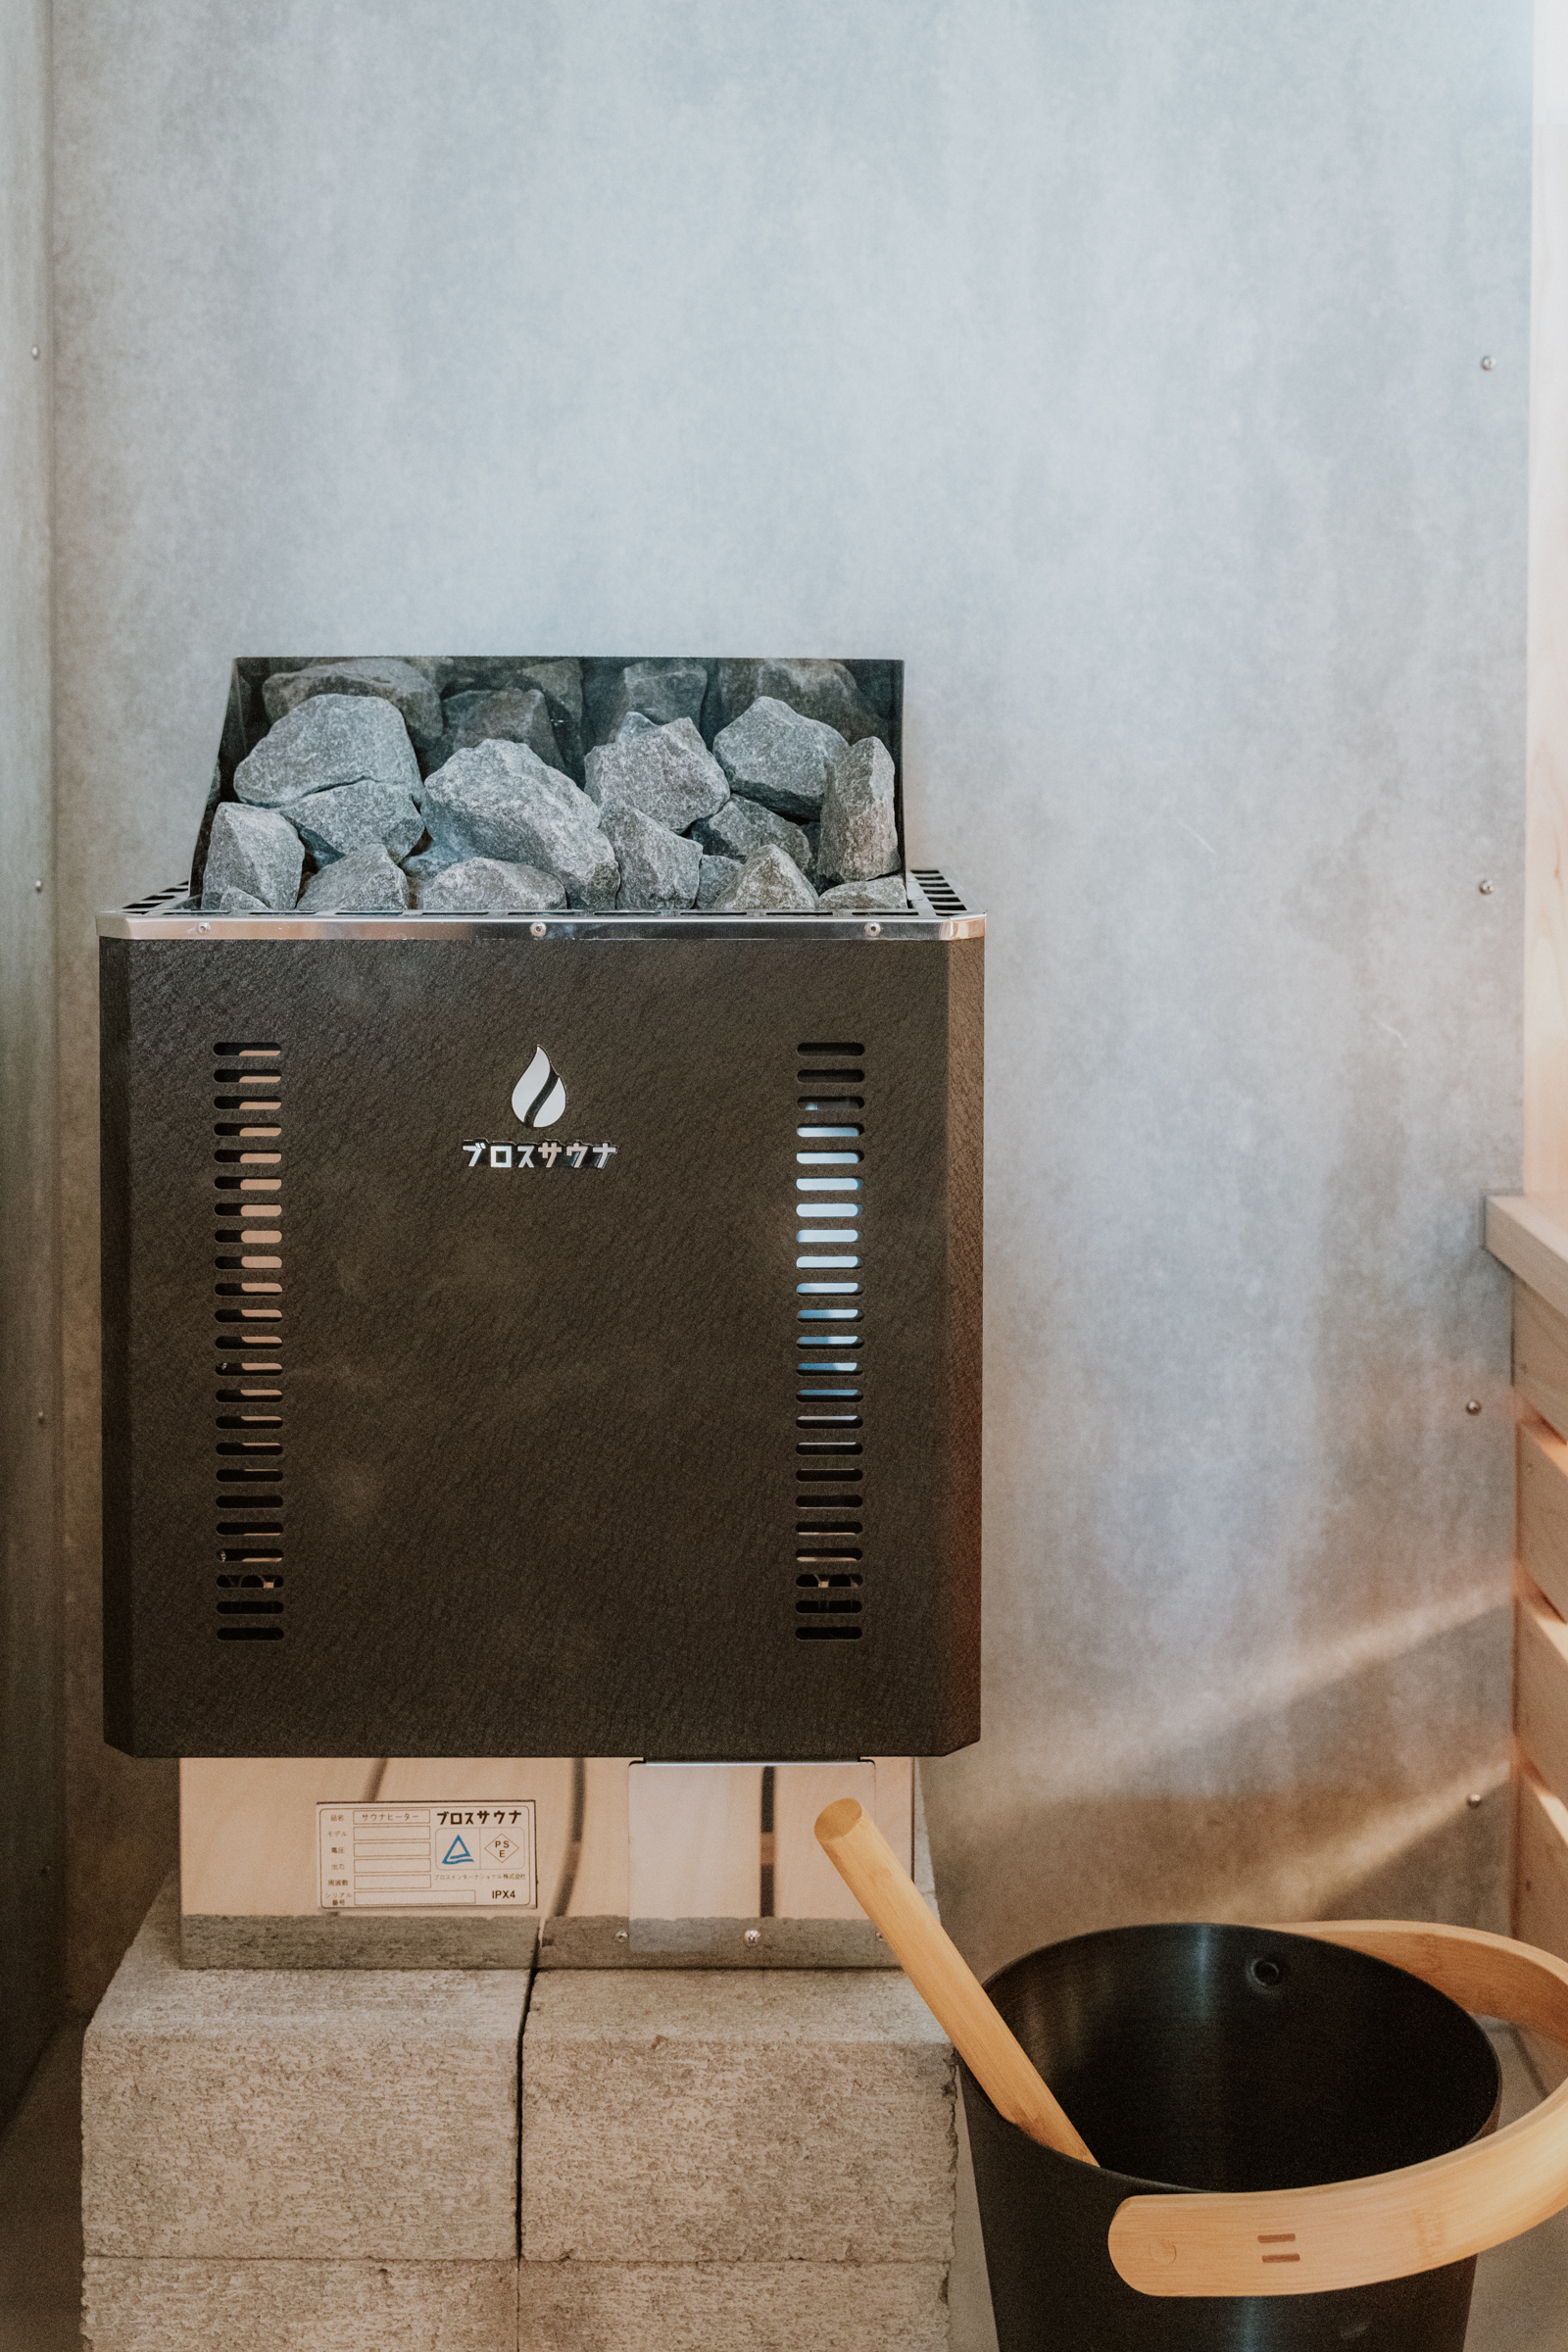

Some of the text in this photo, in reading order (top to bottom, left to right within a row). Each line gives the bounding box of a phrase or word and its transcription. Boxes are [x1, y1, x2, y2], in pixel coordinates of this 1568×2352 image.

[463, 1142, 617, 1168] ブロスサウナ
[362, 1812, 419, 1821] サウナヒーター
[436, 1810, 522, 1825] ブロスサウナ
[491, 1889, 516, 1899] IPX4
